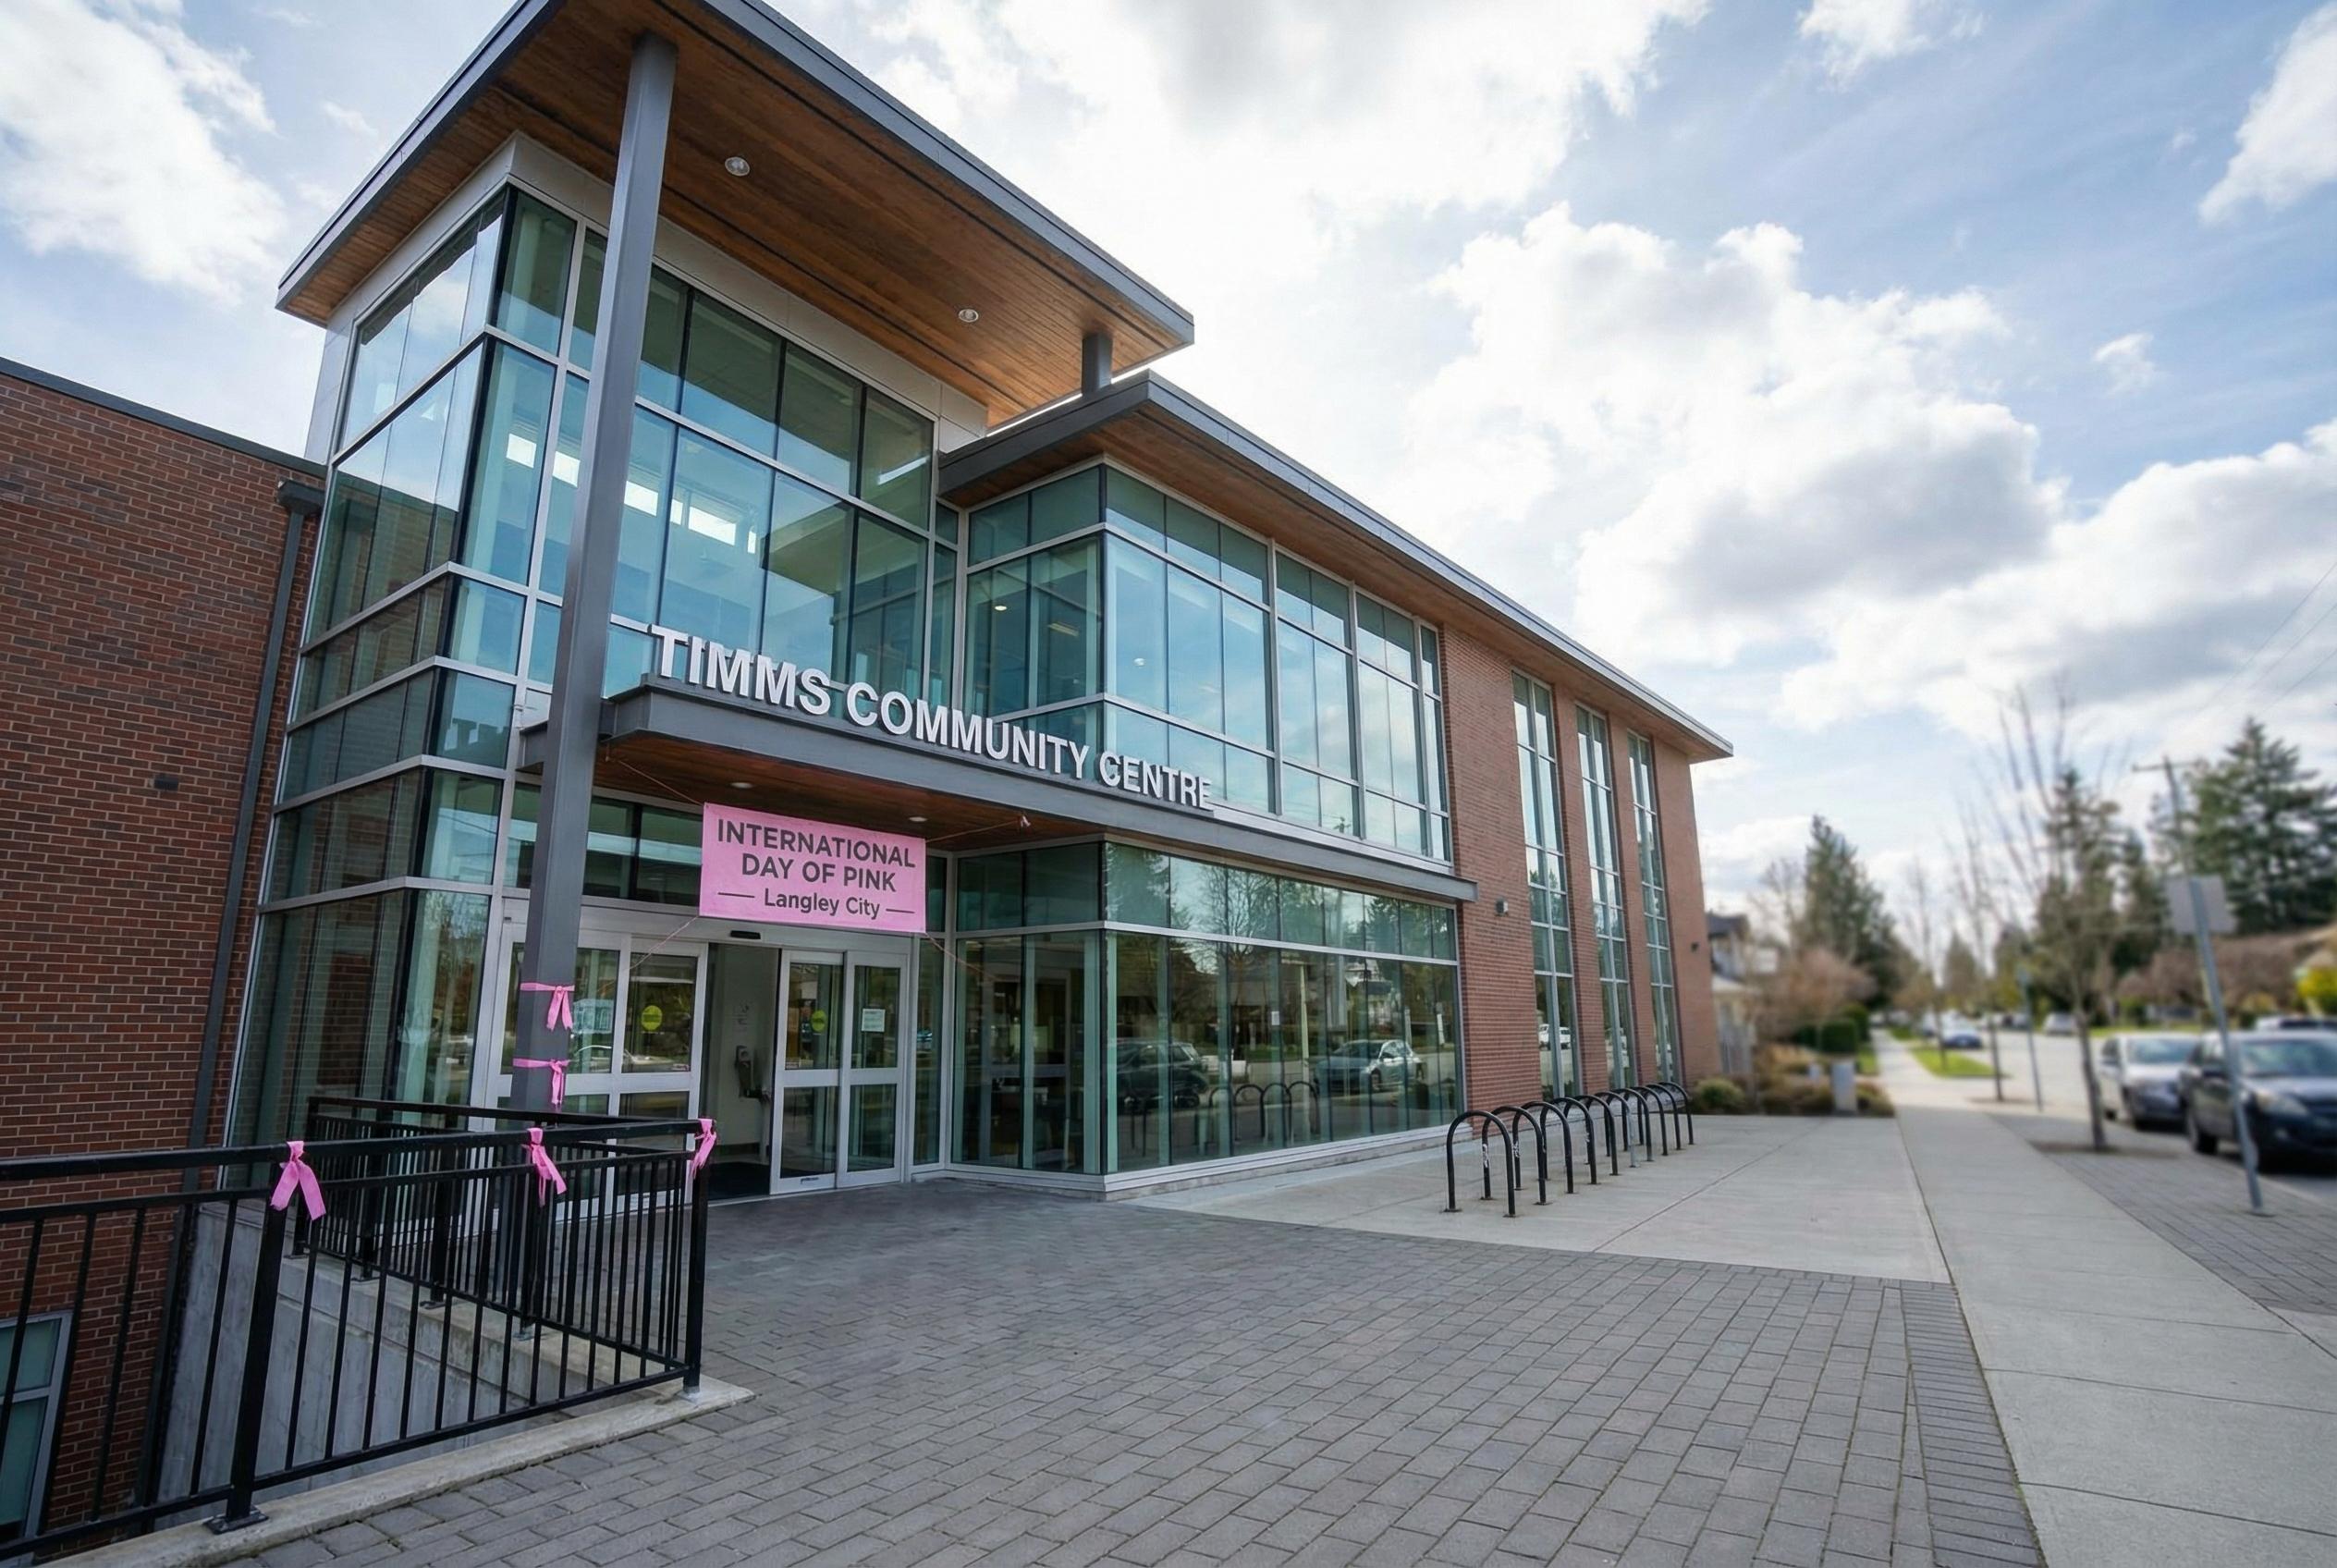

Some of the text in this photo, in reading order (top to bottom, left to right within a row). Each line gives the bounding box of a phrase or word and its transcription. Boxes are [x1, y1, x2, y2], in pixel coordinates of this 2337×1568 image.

[650, 624, 1214, 811] TIMMS COMMUNITY CENTRE
[717, 818, 916, 868] INTERNATIONAL
[741, 852, 897, 892] DAY OF PINK
[765, 888, 880, 920] Langley City
